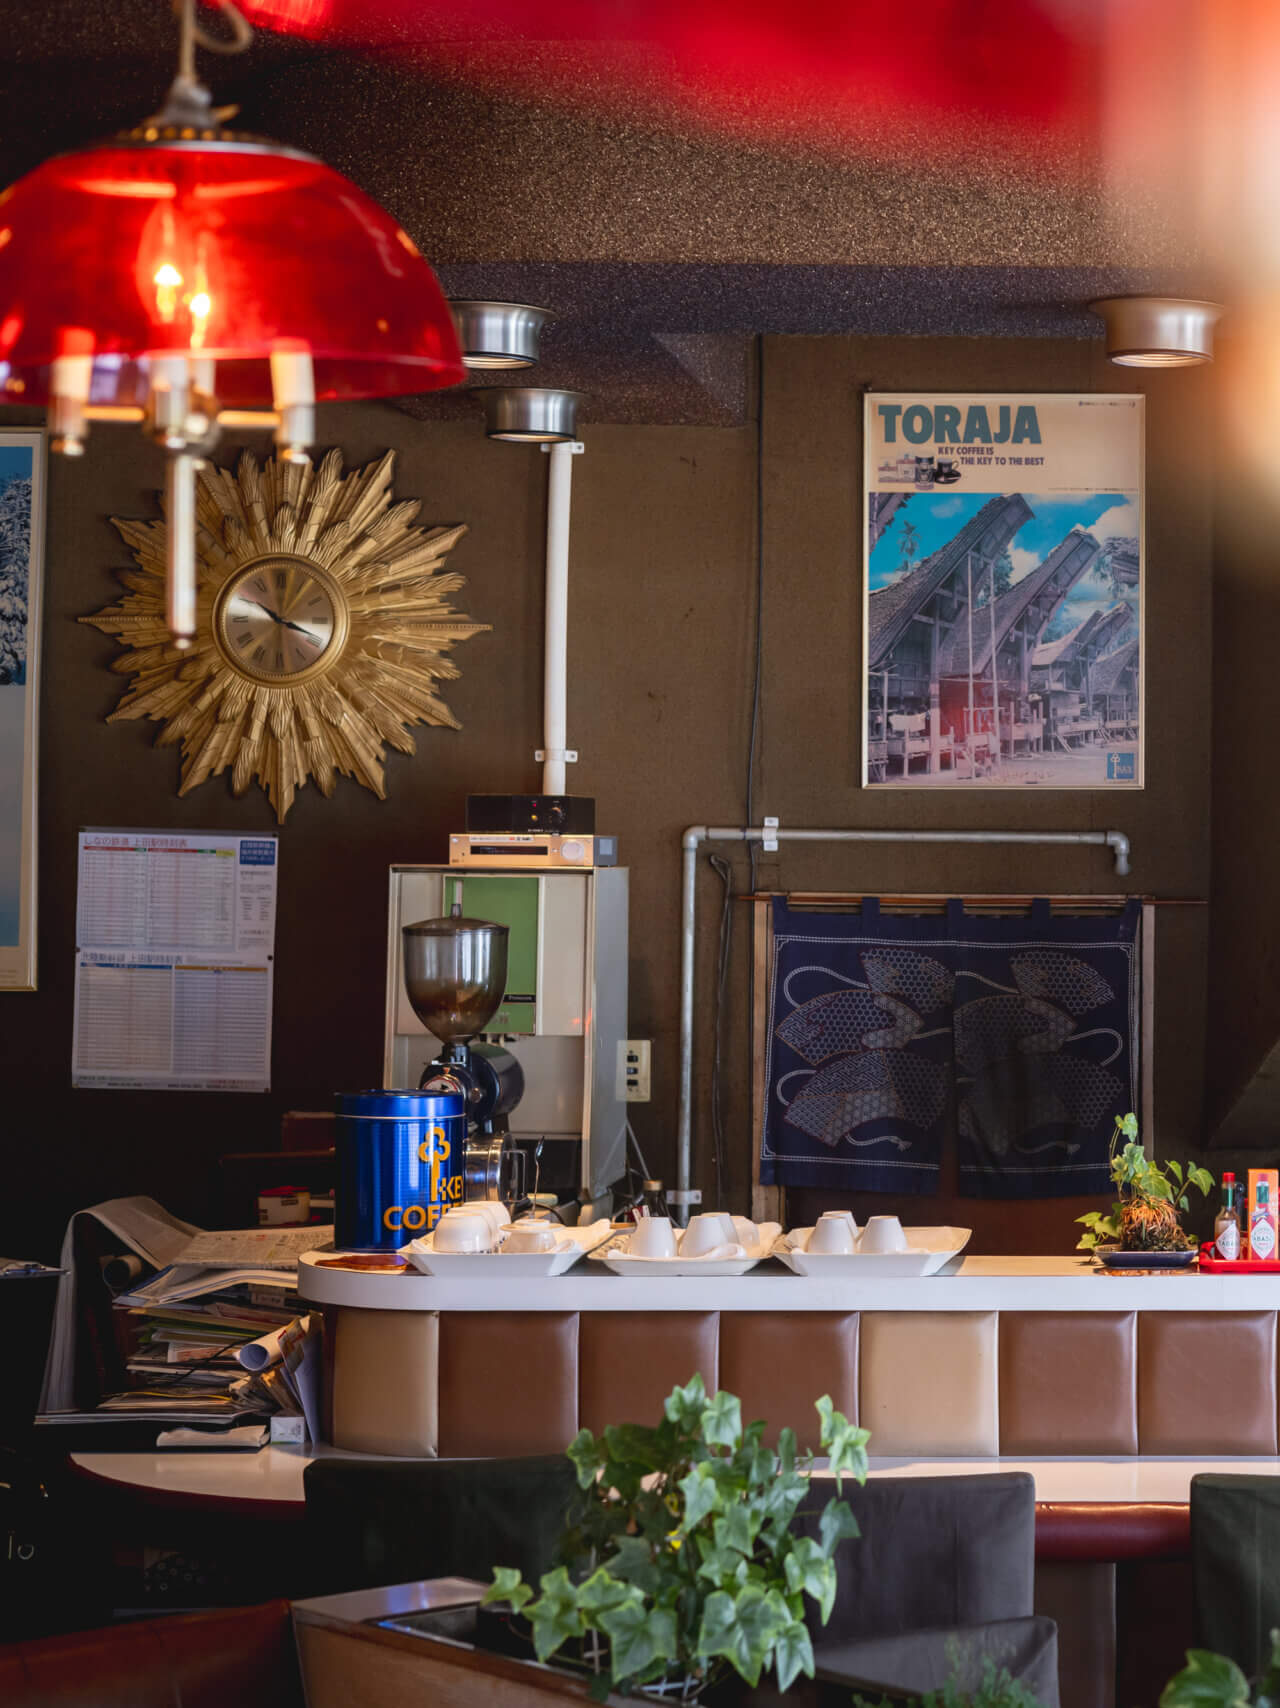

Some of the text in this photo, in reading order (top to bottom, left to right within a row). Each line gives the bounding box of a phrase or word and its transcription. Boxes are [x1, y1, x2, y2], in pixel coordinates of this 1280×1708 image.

[877, 404, 1042, 444] TORAJA
[937, 446, 994, 456] KEY COFFEE IS
[960, 456, 1045, 465] THE KEY TO THE BEST
[439, 1175, 465, 1201] KE
[383, 1201, 465, 1231] COF
